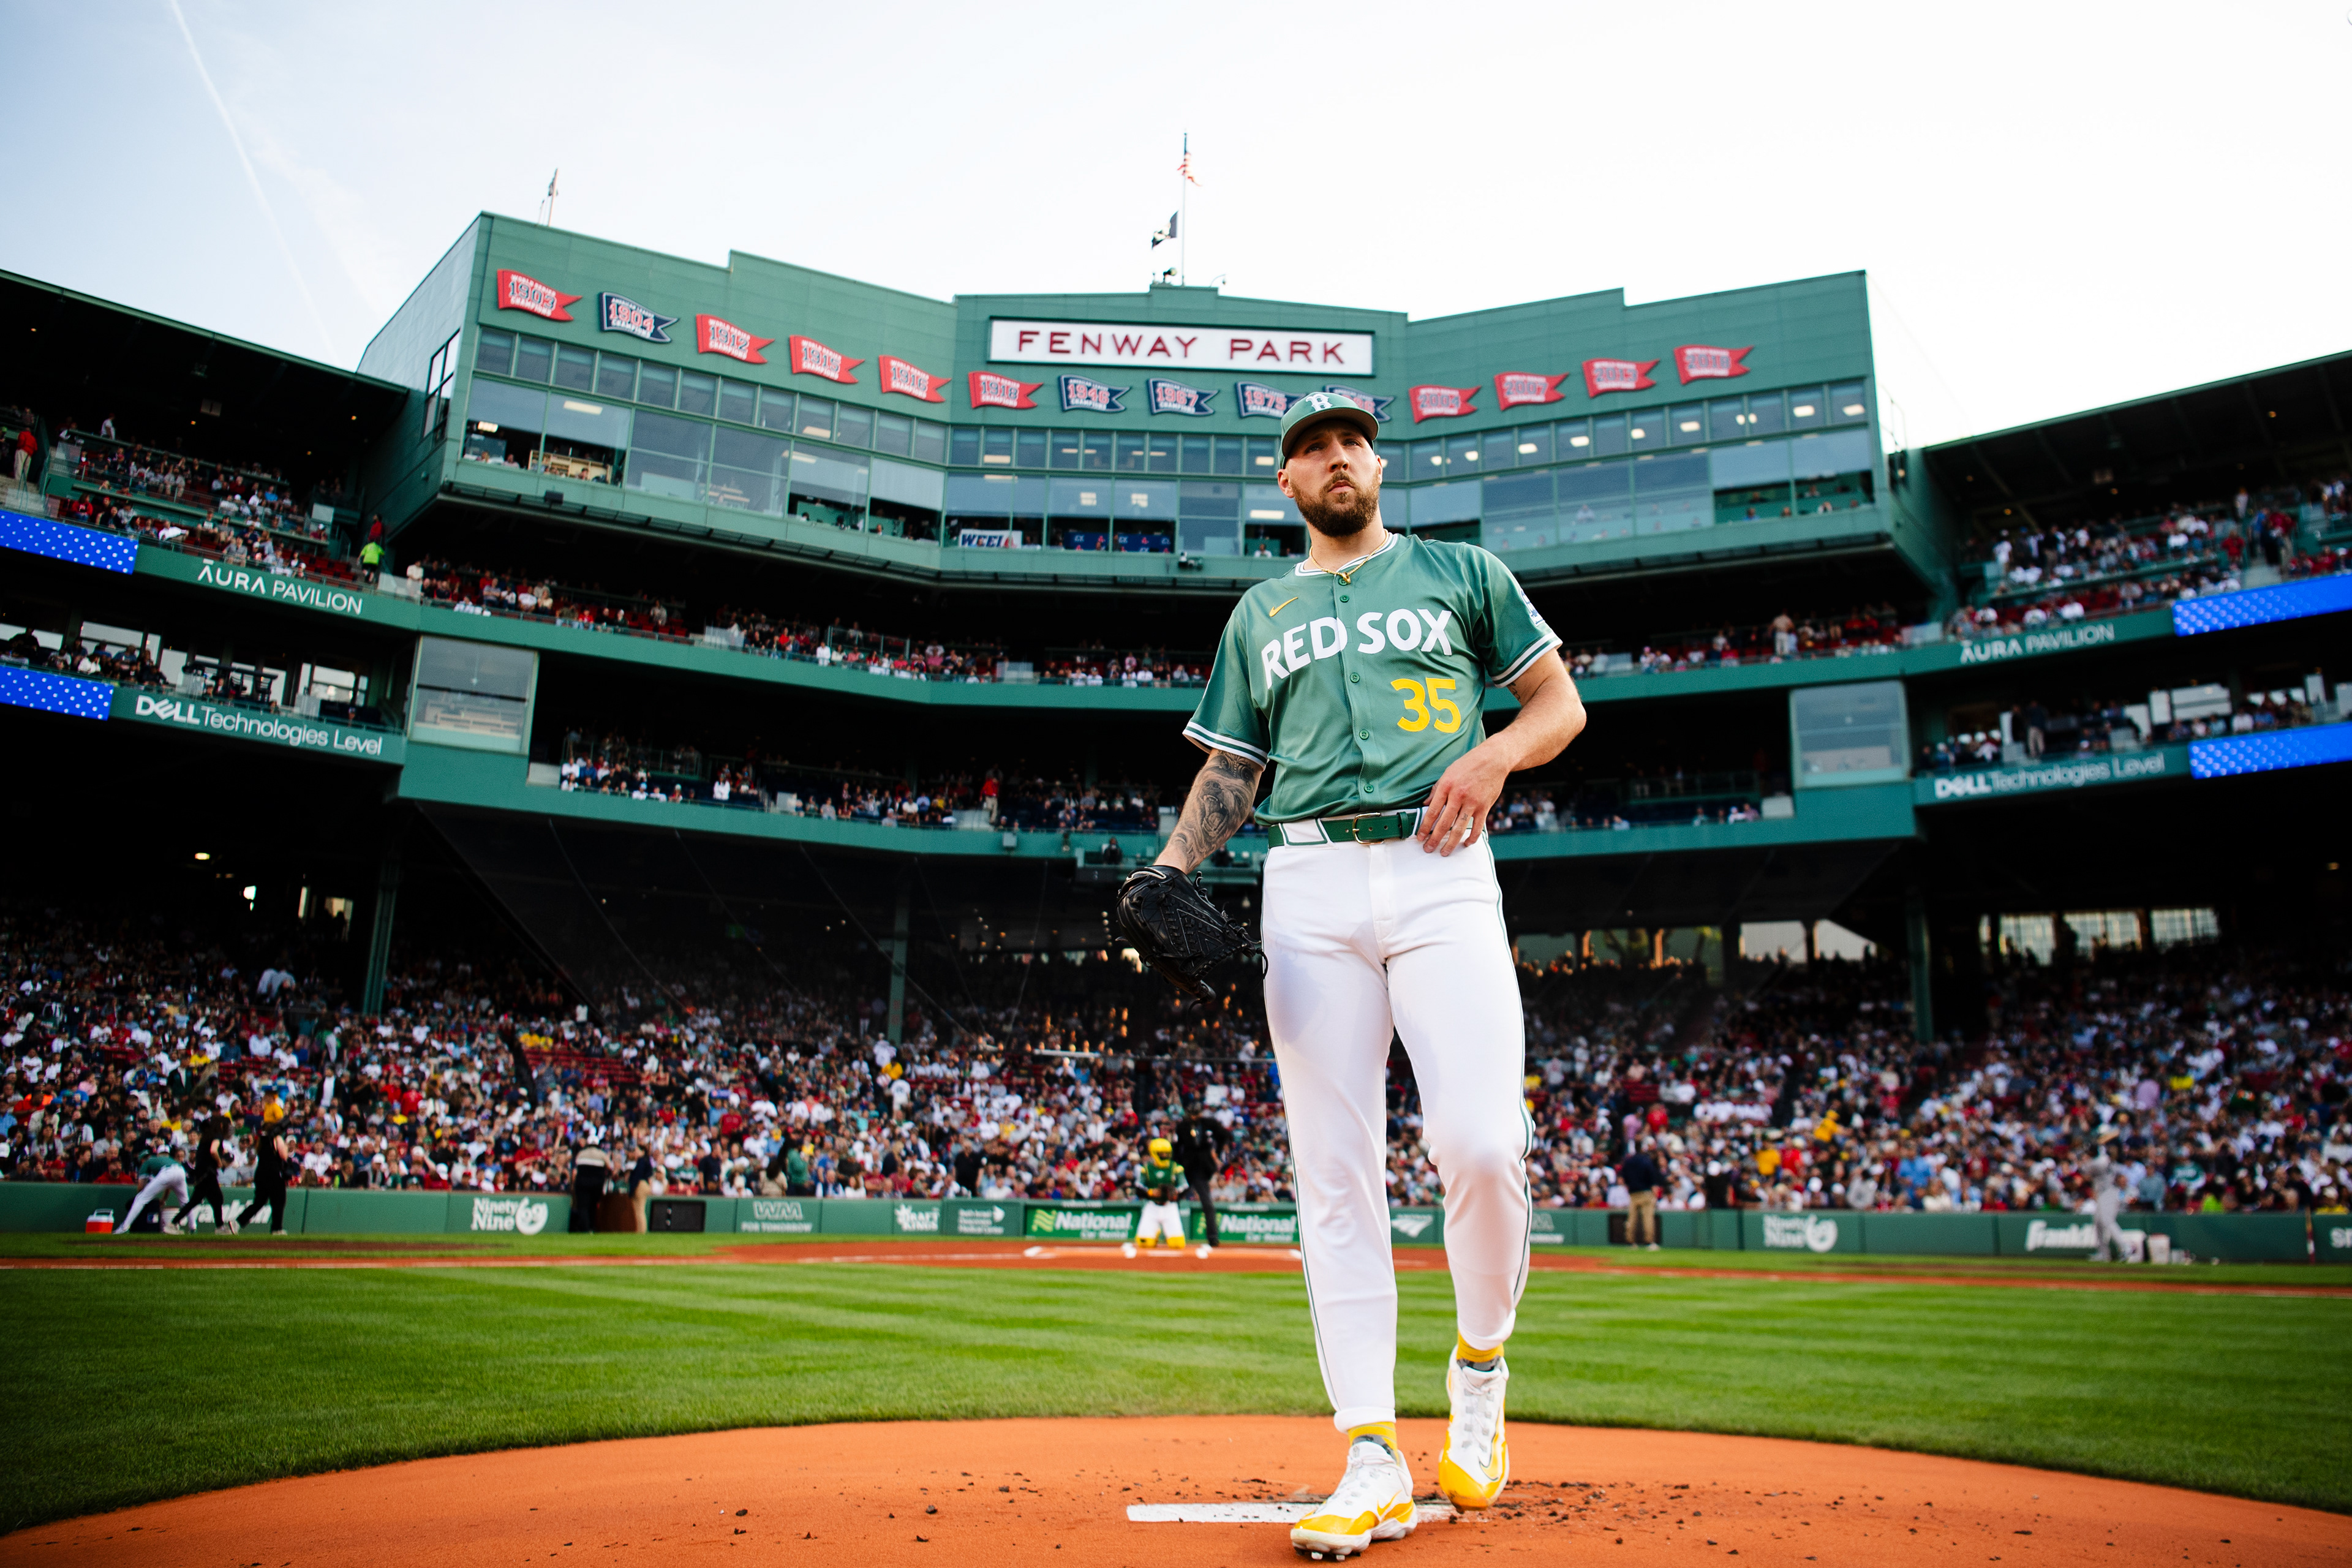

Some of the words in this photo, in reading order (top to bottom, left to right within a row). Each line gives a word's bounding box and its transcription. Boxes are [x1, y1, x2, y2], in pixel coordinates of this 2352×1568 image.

[508, 281, 557, 311] 1903
[609, 303, 655, 333] 1904
[709, 325, 750, 352] 1912
[1019, 331, 1197, 358] FENWAY
[1230, 339, 1344, 364] PARK
[802, 347, 842, 372] 1915
[891, 367, 929, 392] 1916
[981, 380, 1019, 400] 1918
[1502, 380, 1549, 396] 2007
[1067, 383, 1110, 404] 1946
[1156, 387, 1199, 407] 1967
[1245, 390, 1287, 411] 1975
[1305, 393, 1333, 412] B
[1417, 393, 1461, 409] 2004
[273, 580, 363, 615] PAVILION
[1261, 617, 1348, 689] RED
[1357, 609, 1452, 655] SOX
[2025, 624, 2114, 653] PAVILION
[1390, 677, 1461, 733] 35
[136, 695, 200, 726] DELL
[201, 706, 329, 746] Technologies
[334, 729, 382, 755] Level
[1934, 773, 1992, 799] DELL
[1991, 762, 2111, 791] Technologies
[2111, 752, 2165, 778] Level
[473, 1197, 519, 1216] Ninety
[753, 1200, 803, 1220] WM
[897, 1207, 940, 1223] DRAFT
[471, 1212, 515, 1231] Nine
[1055, 1210, 1133, 1231] National
[1219, 1214, 1297, 1232] National
